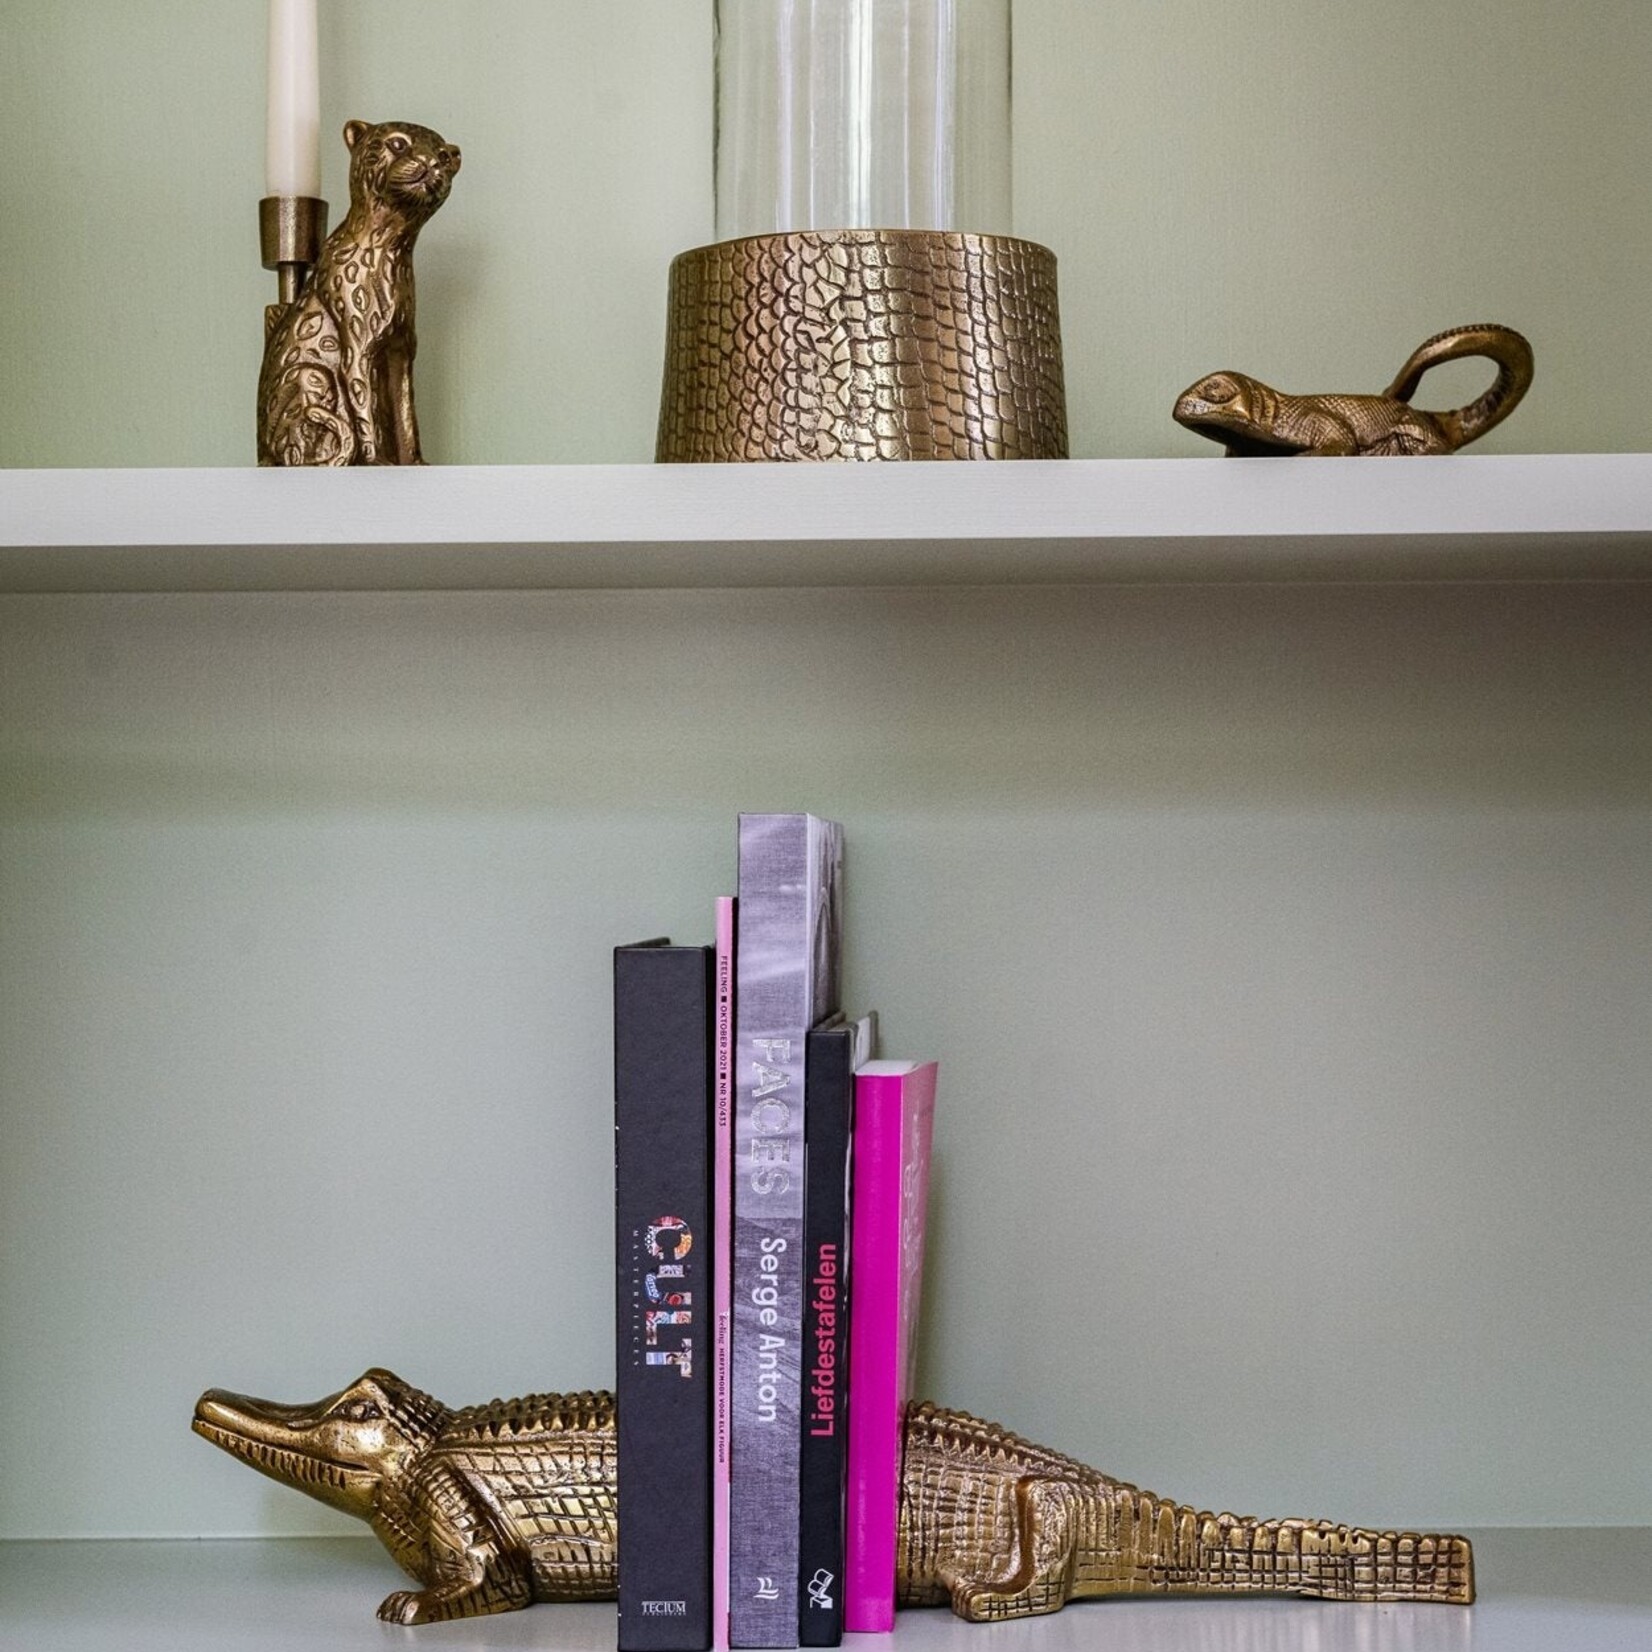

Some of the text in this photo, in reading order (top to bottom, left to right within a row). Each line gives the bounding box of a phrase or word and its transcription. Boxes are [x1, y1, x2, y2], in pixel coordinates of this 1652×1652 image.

[720, 955, 728, 993] FEELING
[720, 1005, 728, 1048] OKTOBER
[719, 1050, 727, 1070] 2021
[719, 1082, 727, 1096] NR
[751, 1038, 791, 1195] FACES
[632, 1230, 640, 1367] MASTERPIECES
[644, 1215, 692, 1378] CULT
[752, 1237, 787, 1422] Serge Anton
[811, 1243, 836, 1437] Liefdestafelen
